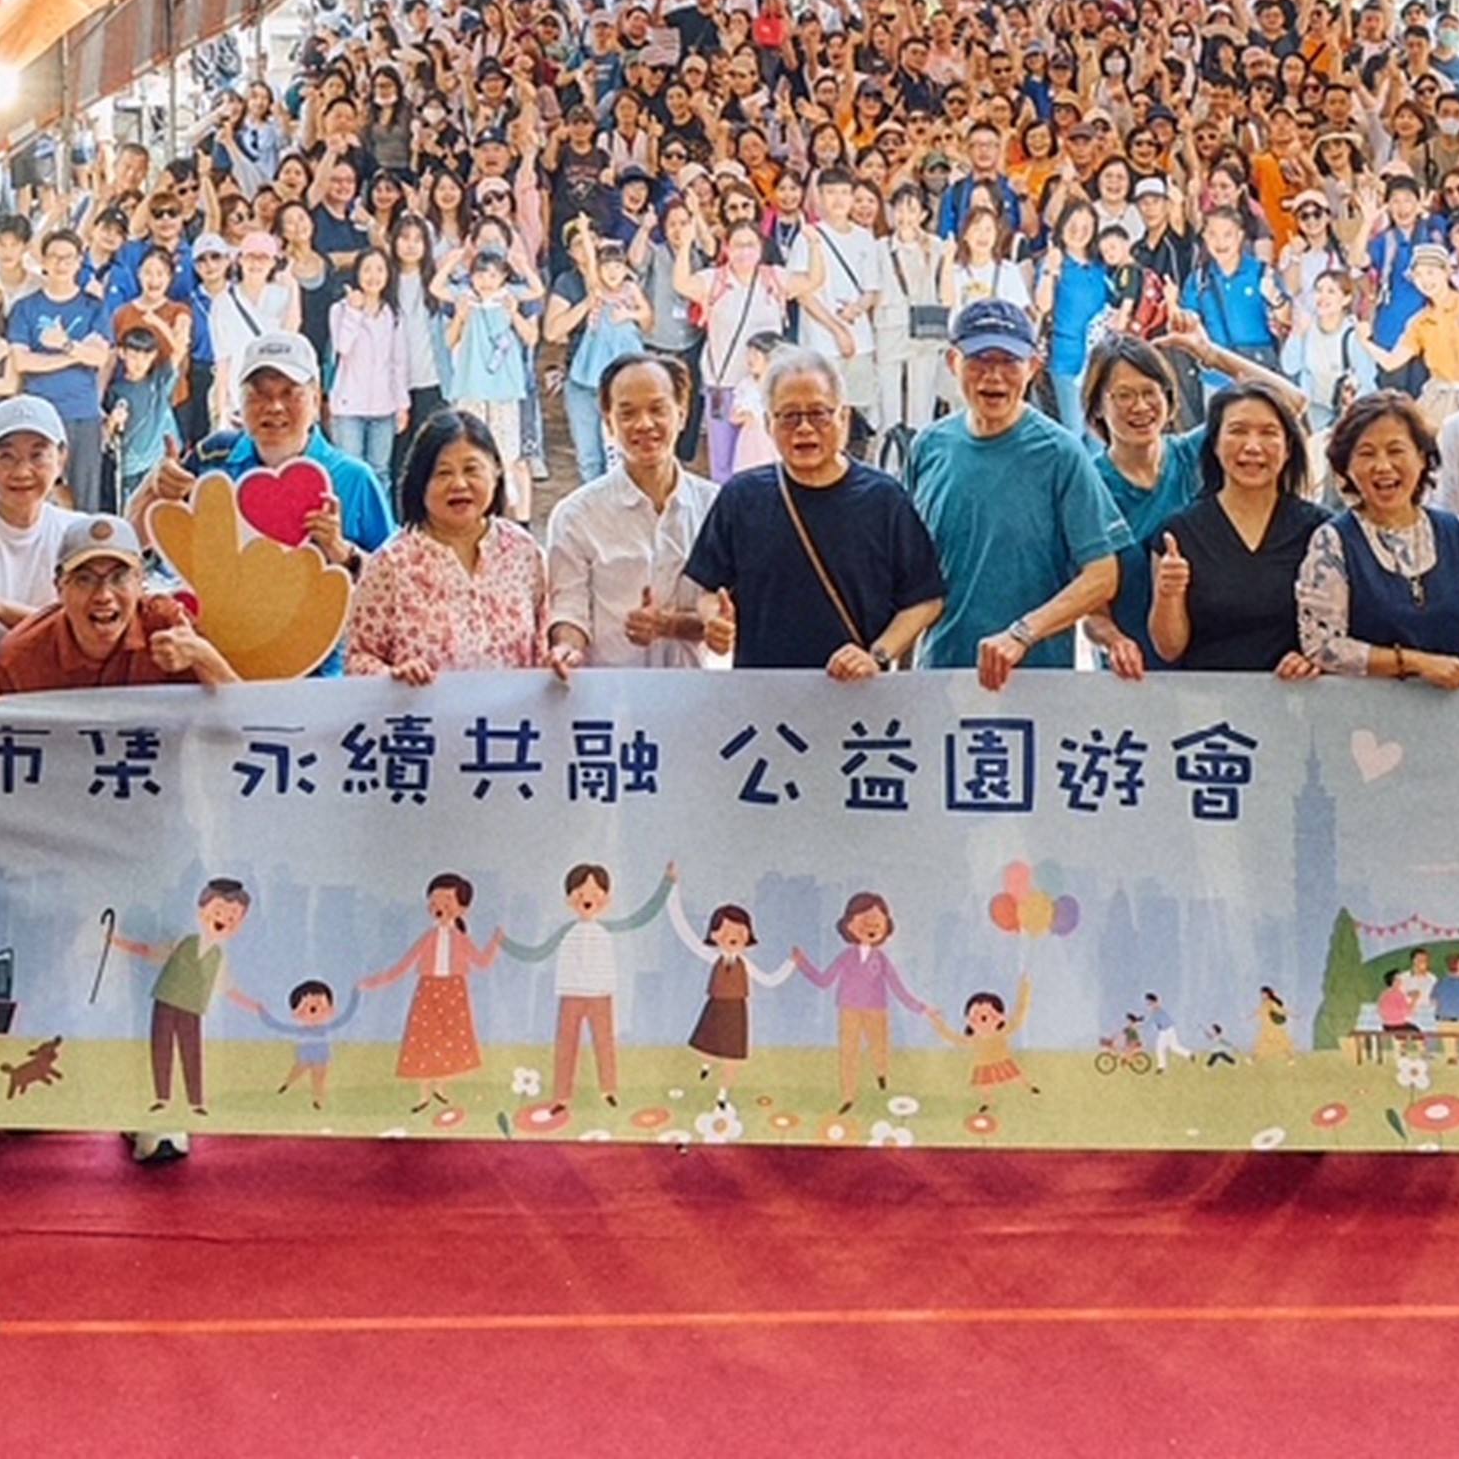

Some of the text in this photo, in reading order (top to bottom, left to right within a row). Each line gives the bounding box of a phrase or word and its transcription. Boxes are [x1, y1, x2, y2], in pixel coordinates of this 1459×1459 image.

[720, 717, 1259, 823] 公益園遊會
